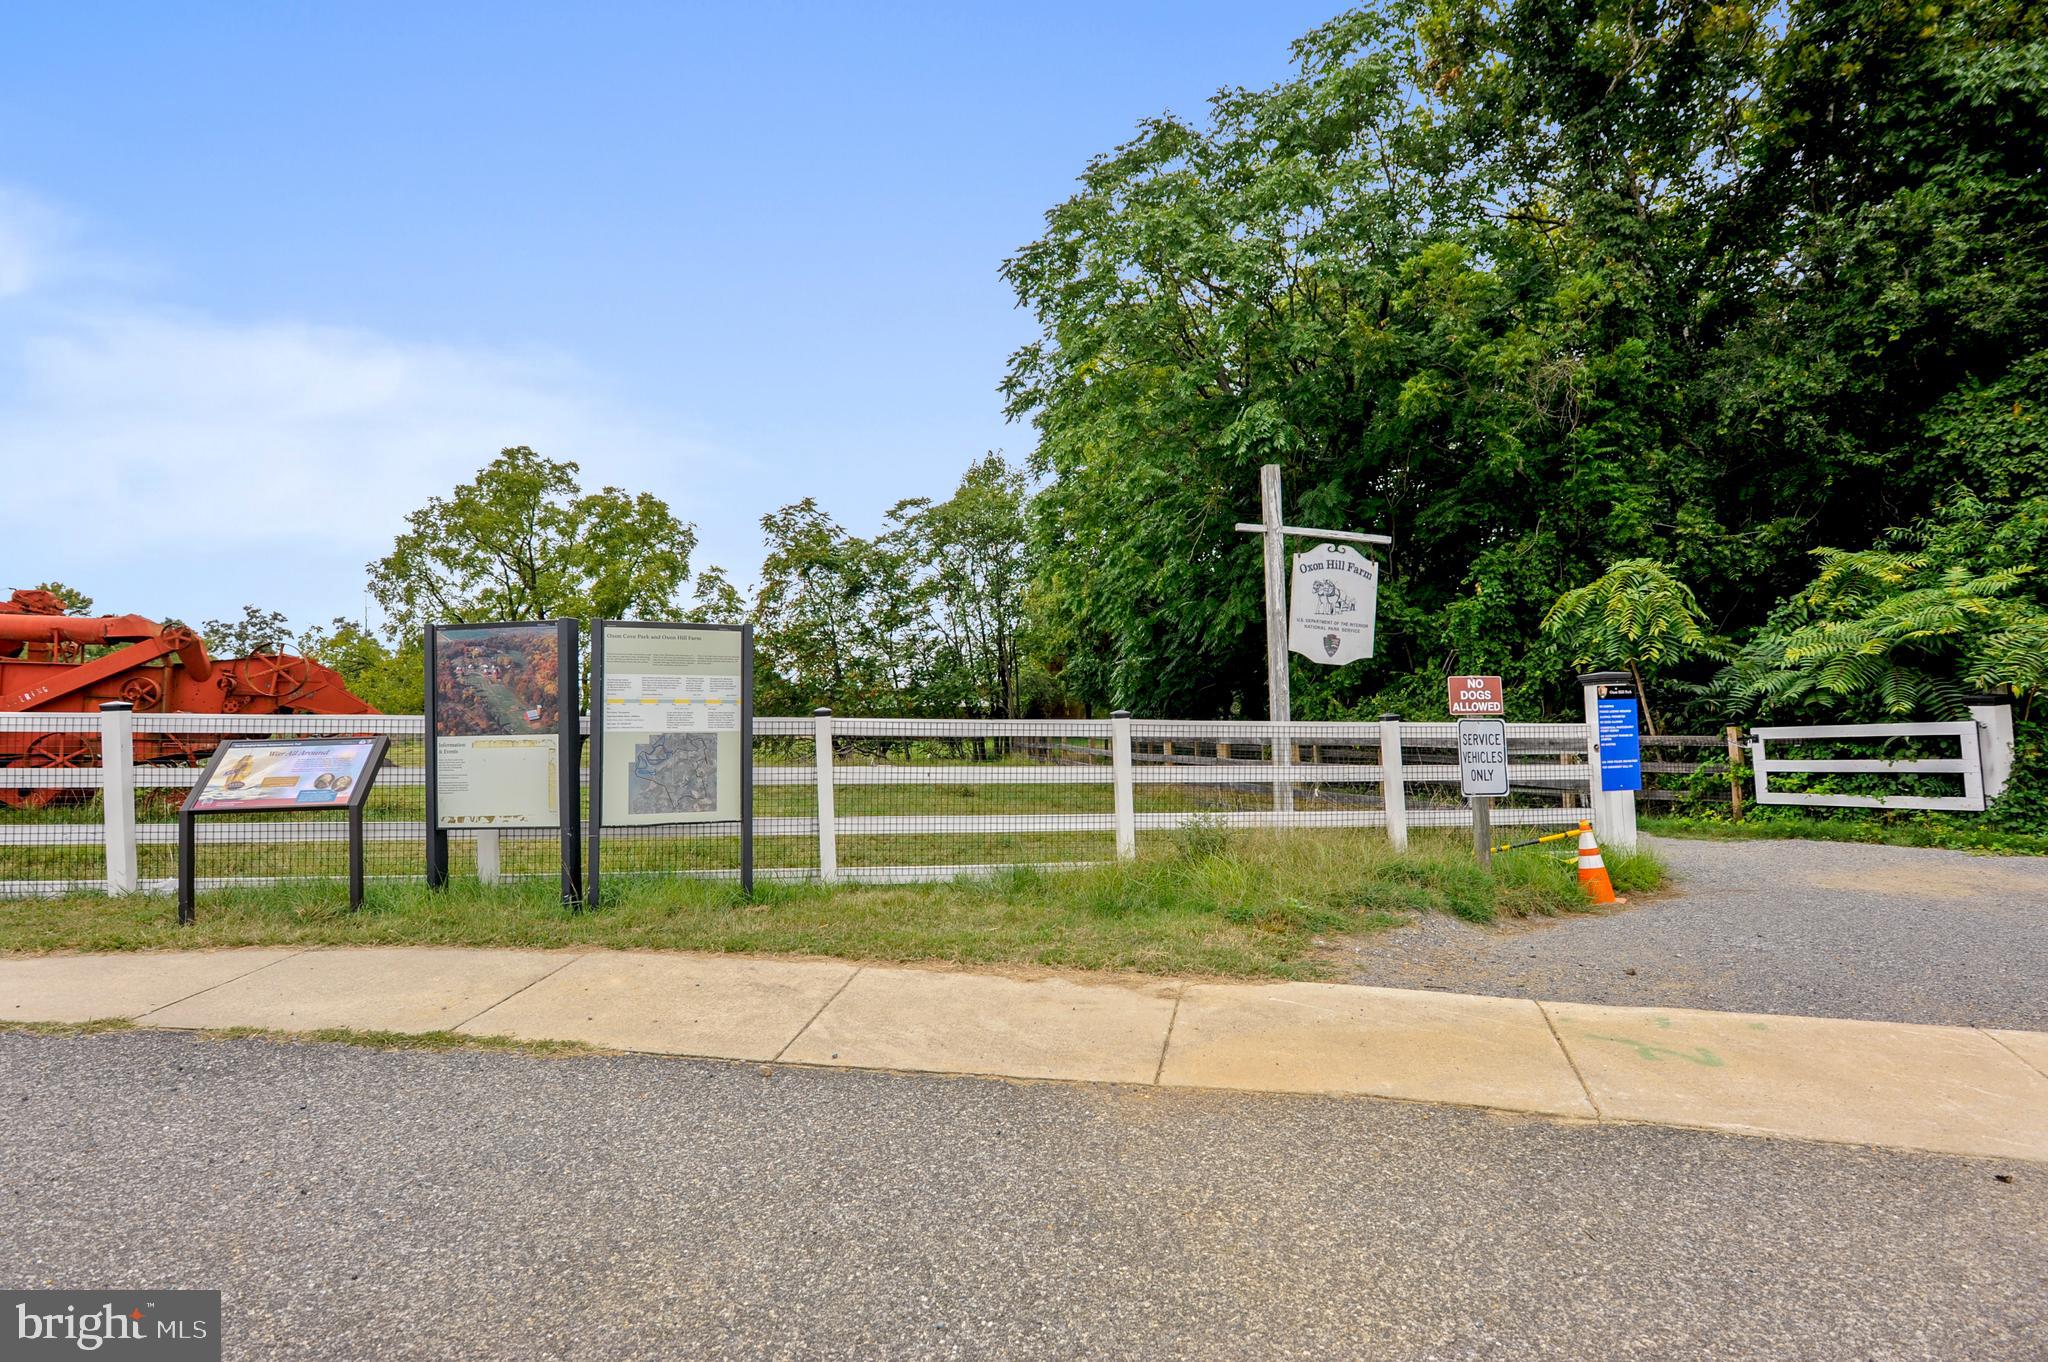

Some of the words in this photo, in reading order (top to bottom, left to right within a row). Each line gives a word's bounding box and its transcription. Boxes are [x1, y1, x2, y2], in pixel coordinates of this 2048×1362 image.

[1299, 562, 1324, 574] Oxon
[1326, 559, 1345, 571] Hill
[1347, 562, 1373, 580] Farm
[1467, 679, 1484, 688] NO
[1460, 690, 1491, 700] DOGS
[1452, 702, 1501, 711] ALLOWED
[1462, 733, 1501, 746] SERVICE
[1462, 751, 1503, 764] VEHICLES
[1471, 769, 1494, 782] ONLY
